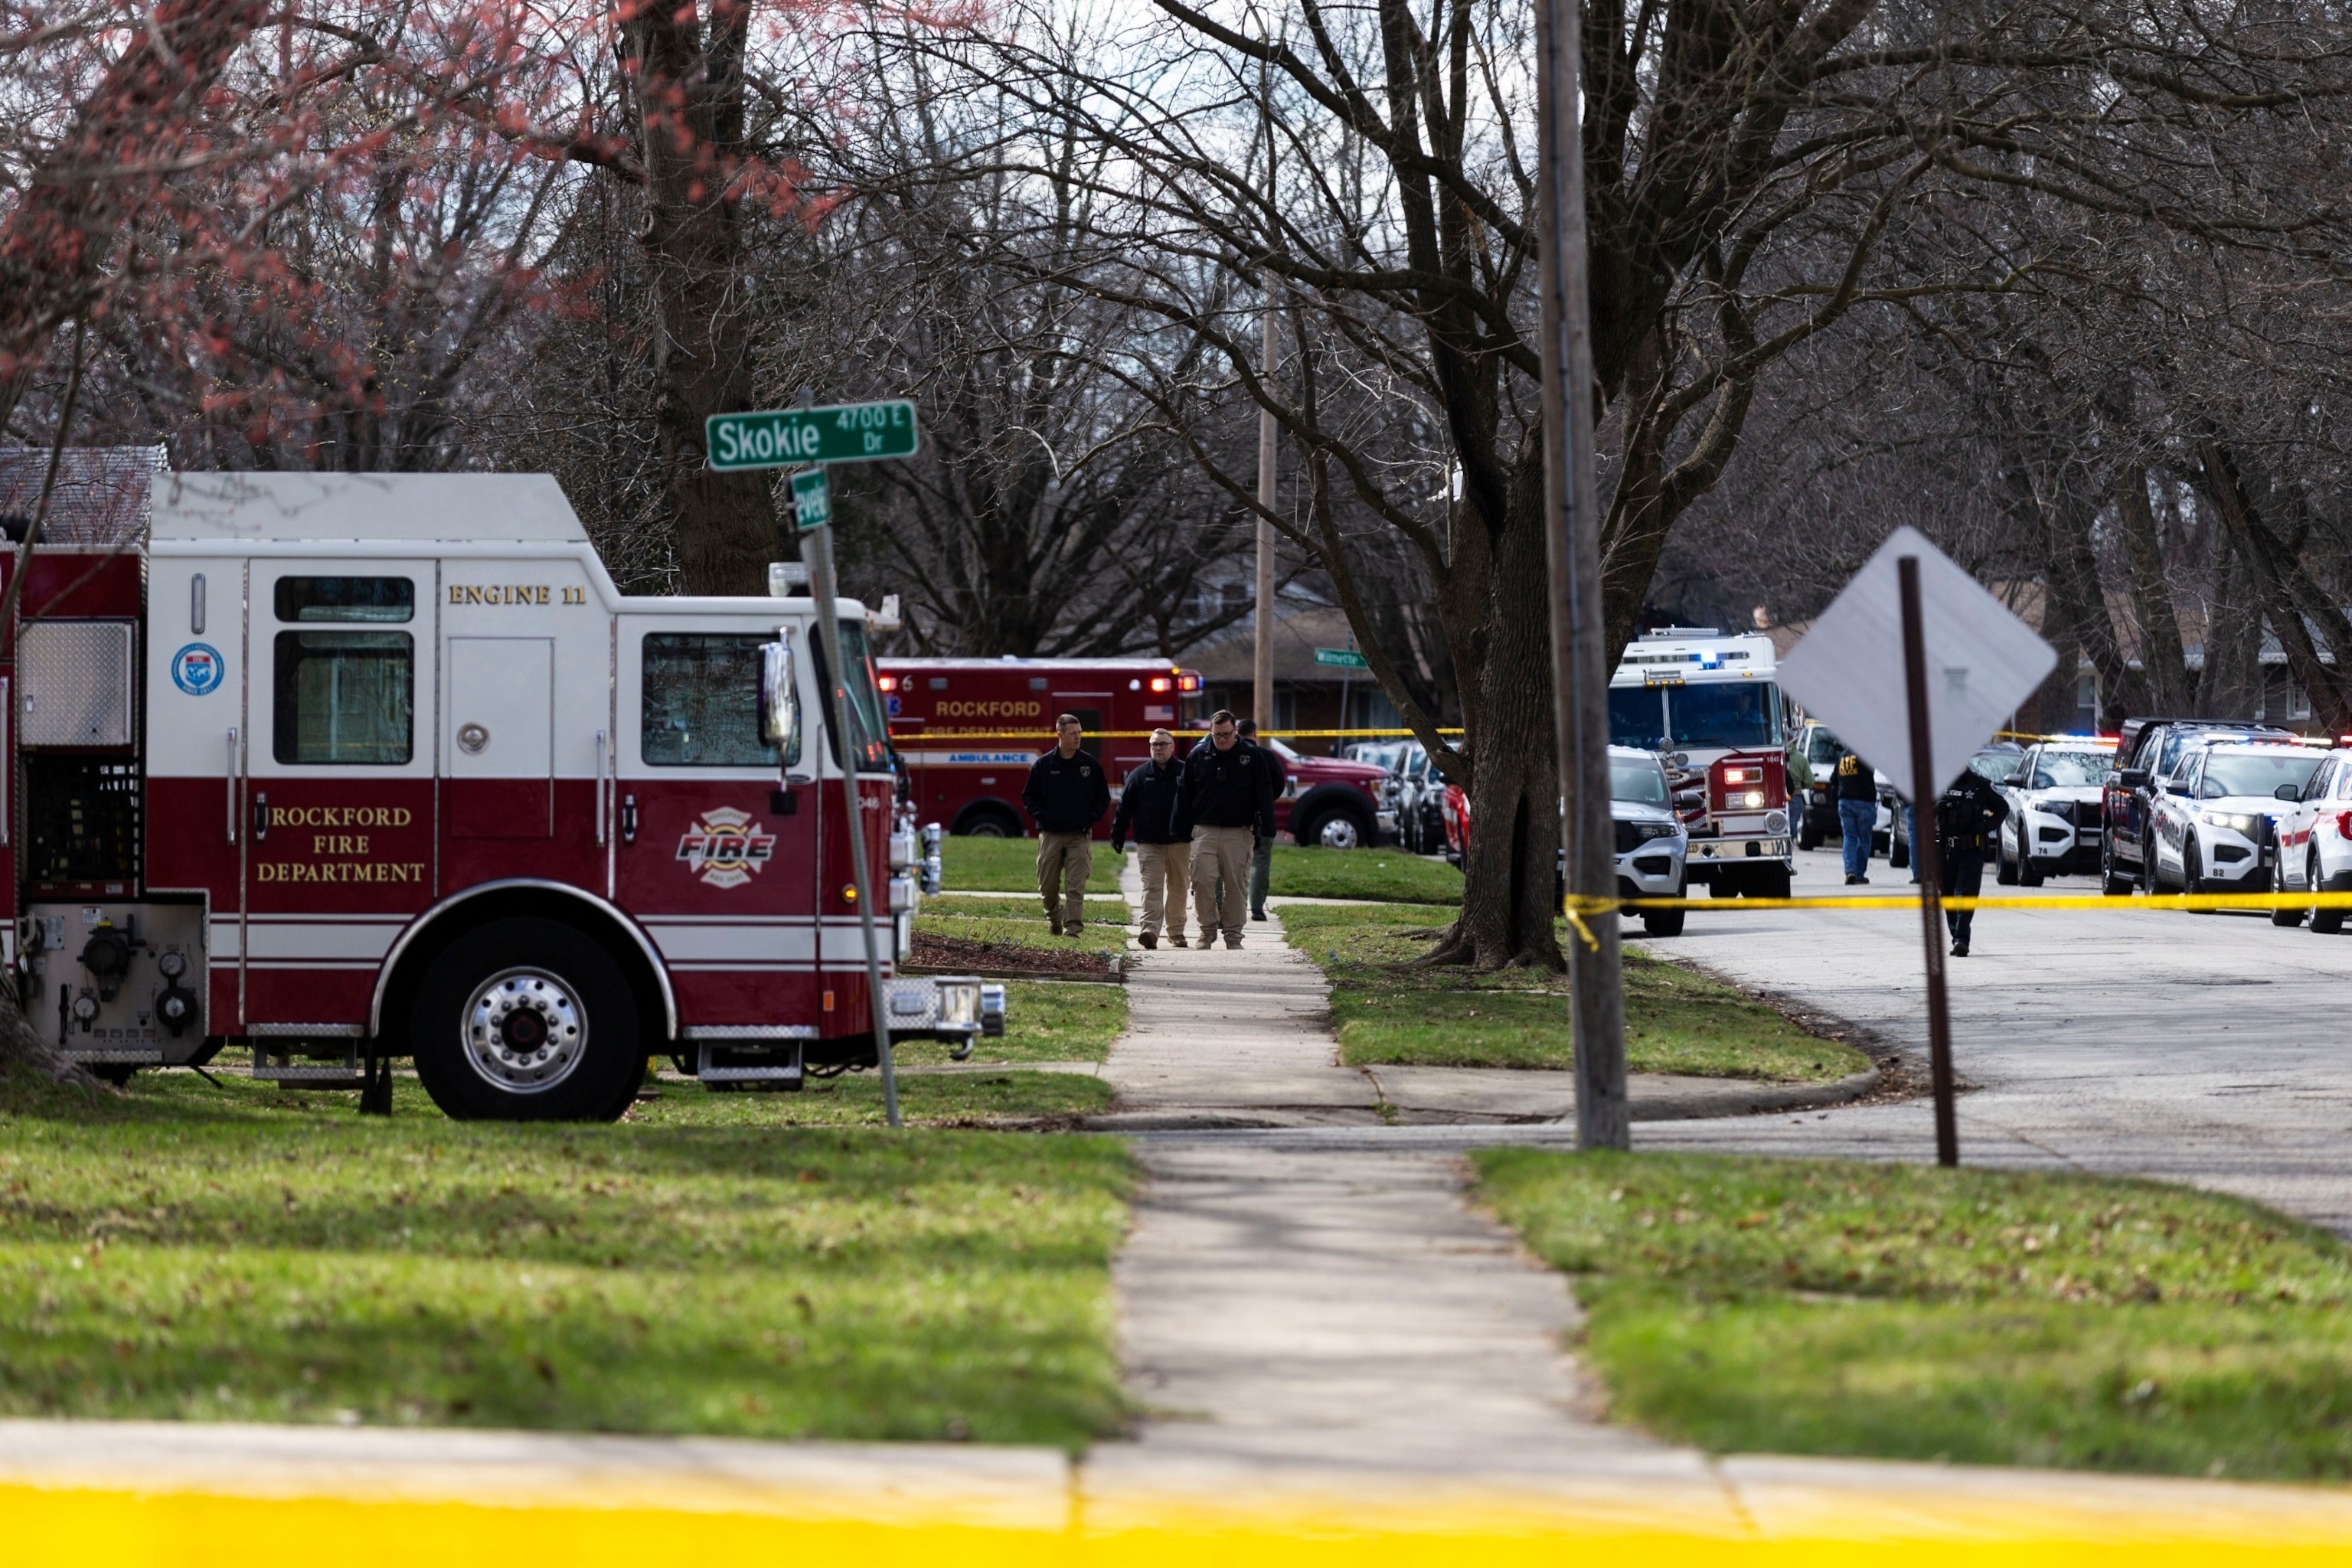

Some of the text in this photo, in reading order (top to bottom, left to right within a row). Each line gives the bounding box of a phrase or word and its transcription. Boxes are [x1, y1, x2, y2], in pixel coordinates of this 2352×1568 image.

[836, 404, 904, 430] 4700 E
[718, 417, 884, 459] Skokie Dr
[449, 584, 586, 605] ENGINE 11
[901, 675, 913, 692] 6
[936, 701, 1041, 717] ROCKFORD
[949, 753, 1028, 763] AMBULANCE
[1839, 755, 1857, 772] ATF
[858, 796, 880, 810] 046
[271, 807, 412, 827] ROCKFORD
[312, 835, 370, 854] FIRE
[676, 835, 776, 861] FIRE
[256, 863, 425, 882] DEPARTMENT
[2213, 868, 2225, 877] 82
